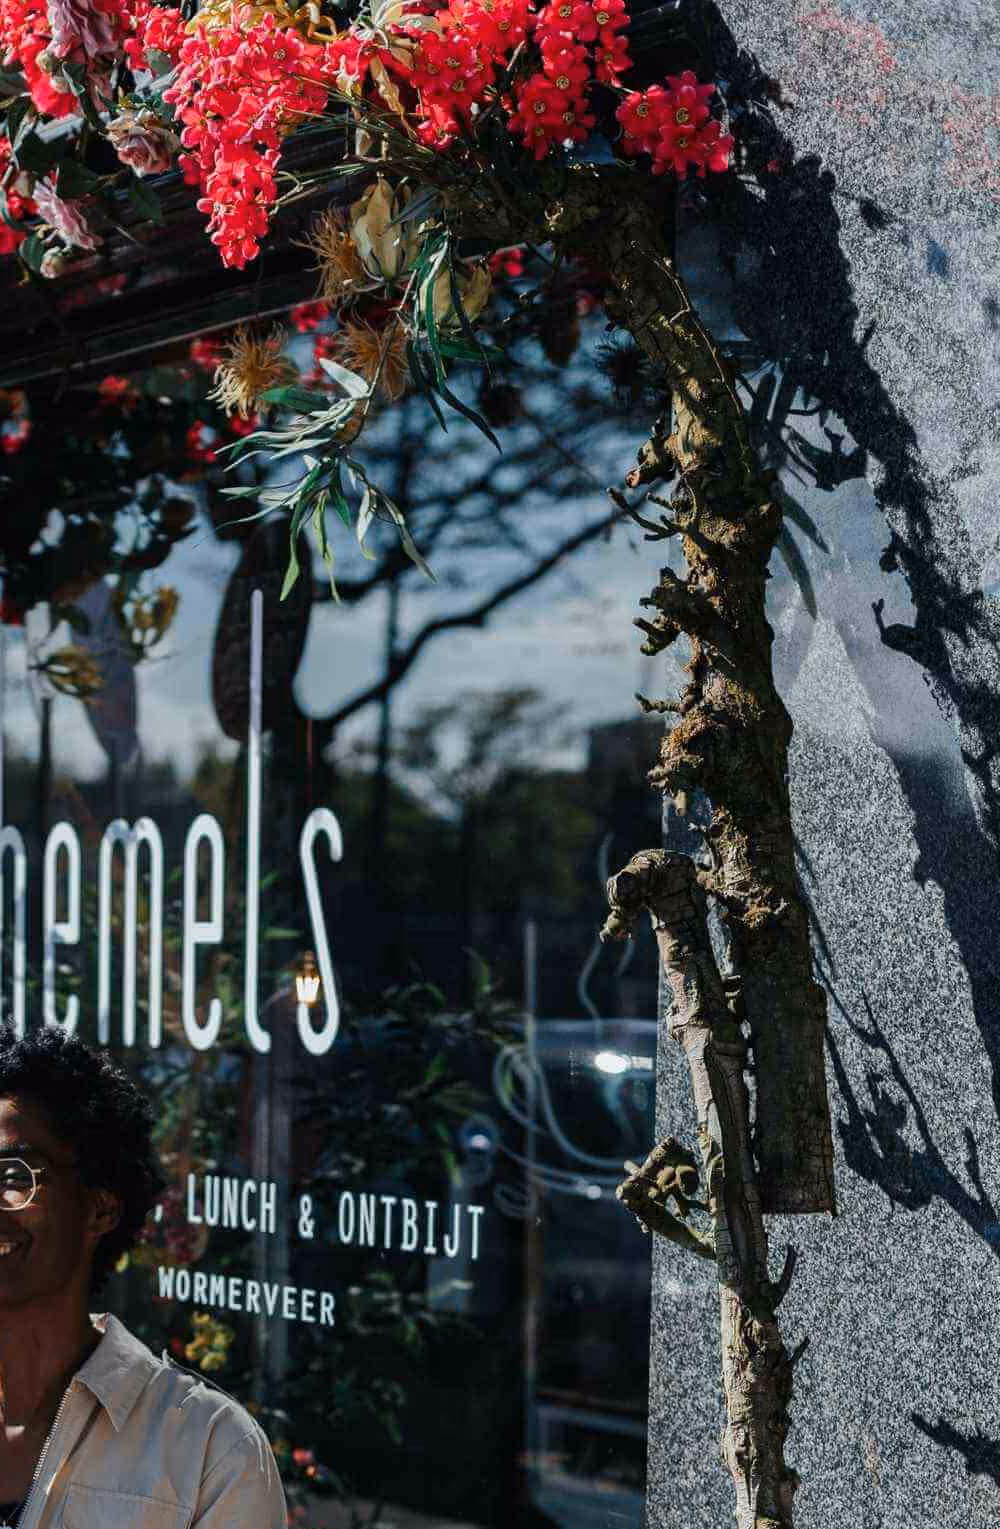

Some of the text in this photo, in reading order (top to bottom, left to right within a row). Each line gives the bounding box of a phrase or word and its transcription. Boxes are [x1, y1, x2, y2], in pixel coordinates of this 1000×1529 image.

[187, 1173, 485, 1261] LUNCH & ONTBIJT
[157, 1265, 336, 1327] WORMERVEER
